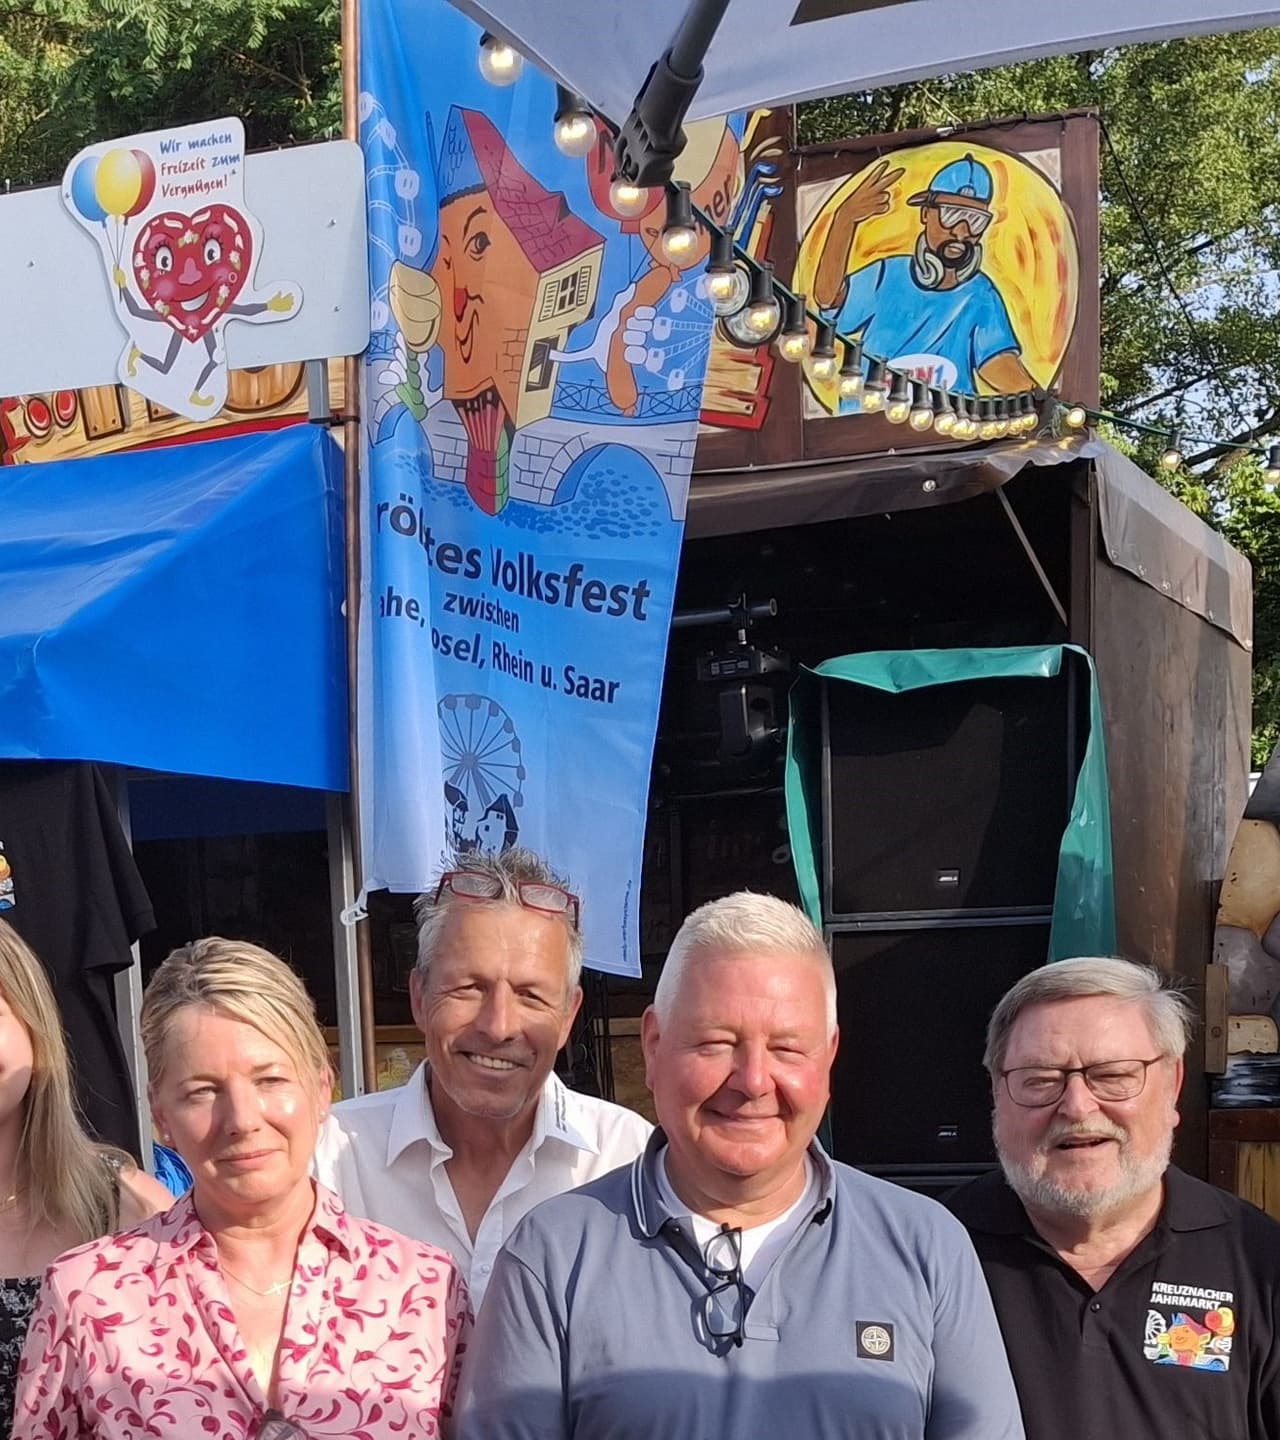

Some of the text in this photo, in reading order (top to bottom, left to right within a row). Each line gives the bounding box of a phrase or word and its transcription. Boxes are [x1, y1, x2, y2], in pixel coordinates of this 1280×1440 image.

[160, 133, 232, 154] Wir machen
[161, 153, 241, 176] Freizeit zum
[162, 174, 228, 198] Vergnügen!
[377, 492, 651, 621] rötes Volksfest
[431, 629, 487, 669] osel,
[492, 641, 535, 681] Rhein
[563, 665, 620, 704] Saar
[1150, 1293, 1221, 1311] JAHRMARKT
[1152, 1281, 1234, 1303] KREUZNACHER
